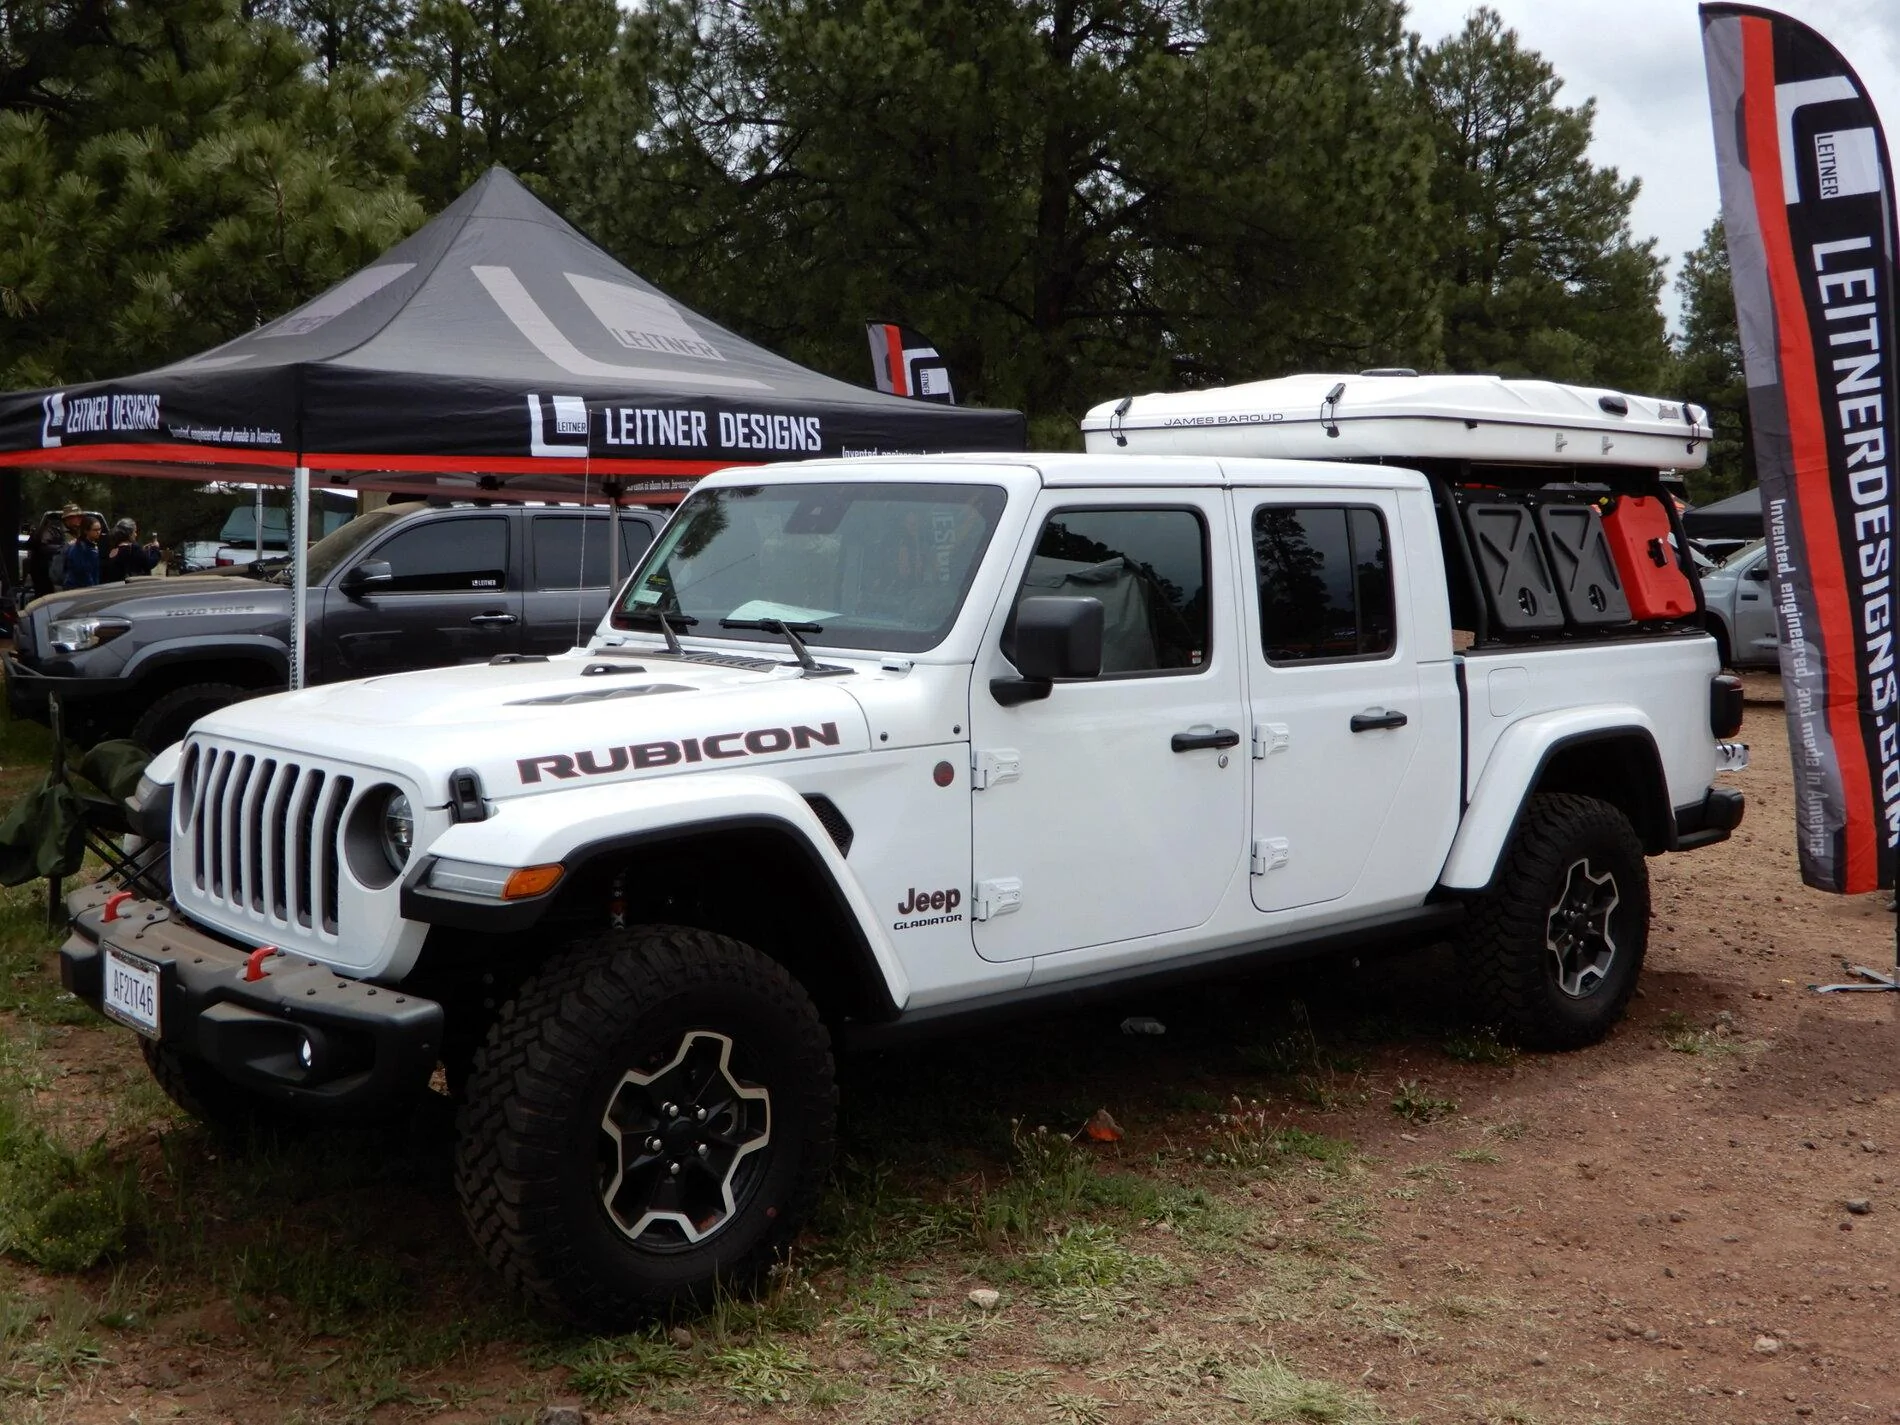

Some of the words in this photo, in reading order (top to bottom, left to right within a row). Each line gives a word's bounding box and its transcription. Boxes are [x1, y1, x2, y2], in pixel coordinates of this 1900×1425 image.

[1816, 134, 1839, 196] LEITNER
[611, 327, 722, 359] LEITNER
[921, 370, 930, 394] LEITNER
[66, 396, 108, 433] LEITNER
[111, 394, 160, 430] DESIGNS
[557, 421, 587, 433] LEITNER
[1164, 417, 1214, 426] JAMES
[1218, 413, 1284, 424] BAROUD
[605, 408, 708, 447] LEITNER
[719, 411, 822, 451] DESIGNS
[1770, 498, 1797, 578] Invented,
[166, 608, 207, 617] TOYO
[209, 605, 255, 615] TIRES
[1797, 687, 1817, 718] and
[516, 721, 840, 785] RUBICON
[1801, 721, 1825, 767] made
[1805, 771, 1826, 786] in
[898, 887, 961, 915] Jeep
[893, 914, 962, 931] GLADIATOR
